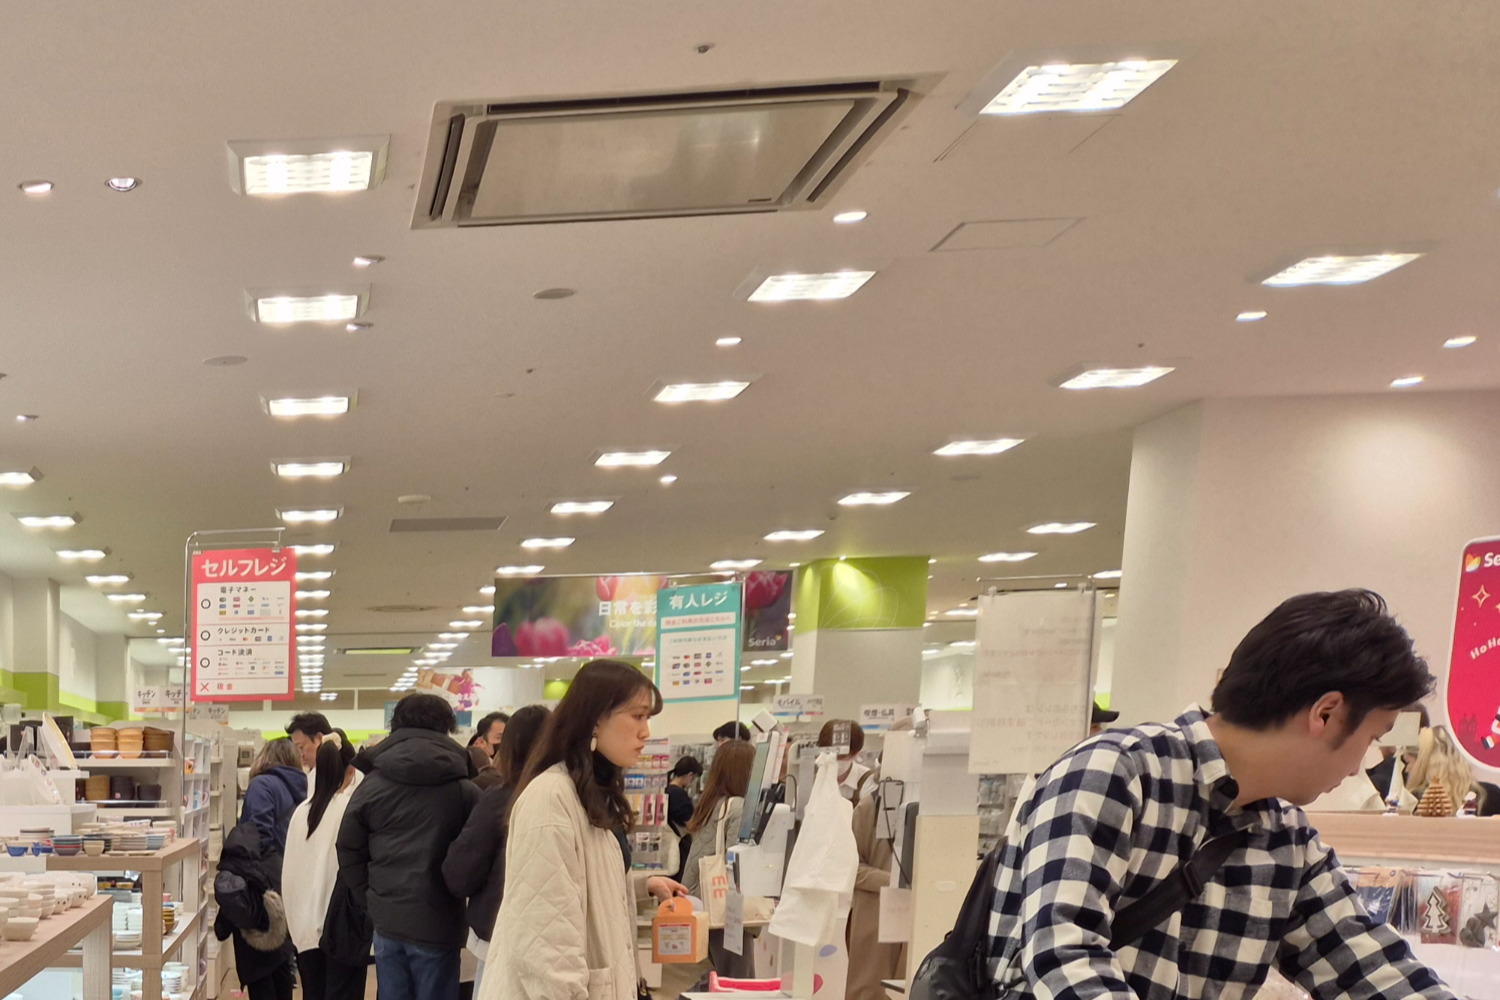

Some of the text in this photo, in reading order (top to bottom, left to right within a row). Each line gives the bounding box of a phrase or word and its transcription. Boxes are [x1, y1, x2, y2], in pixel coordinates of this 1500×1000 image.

[1484, 551, 1500, 568] Se
[201, 556, 287, 578] セルフレジ
[220, 586, 257, 594] 電子マネー
[669, 591, 728, 610] 有人レジ
[609, 619, 632, 628] Color
[217, 626, 270, 635] クレジットカード
[748, 636, 776, 647] Seria
[217, 648, 253, 656] コード決済
[217, 682, 233, 691] 現金
[137, 689, 156, 698] キッチン
[208, 707, 226, 715] キッチン
